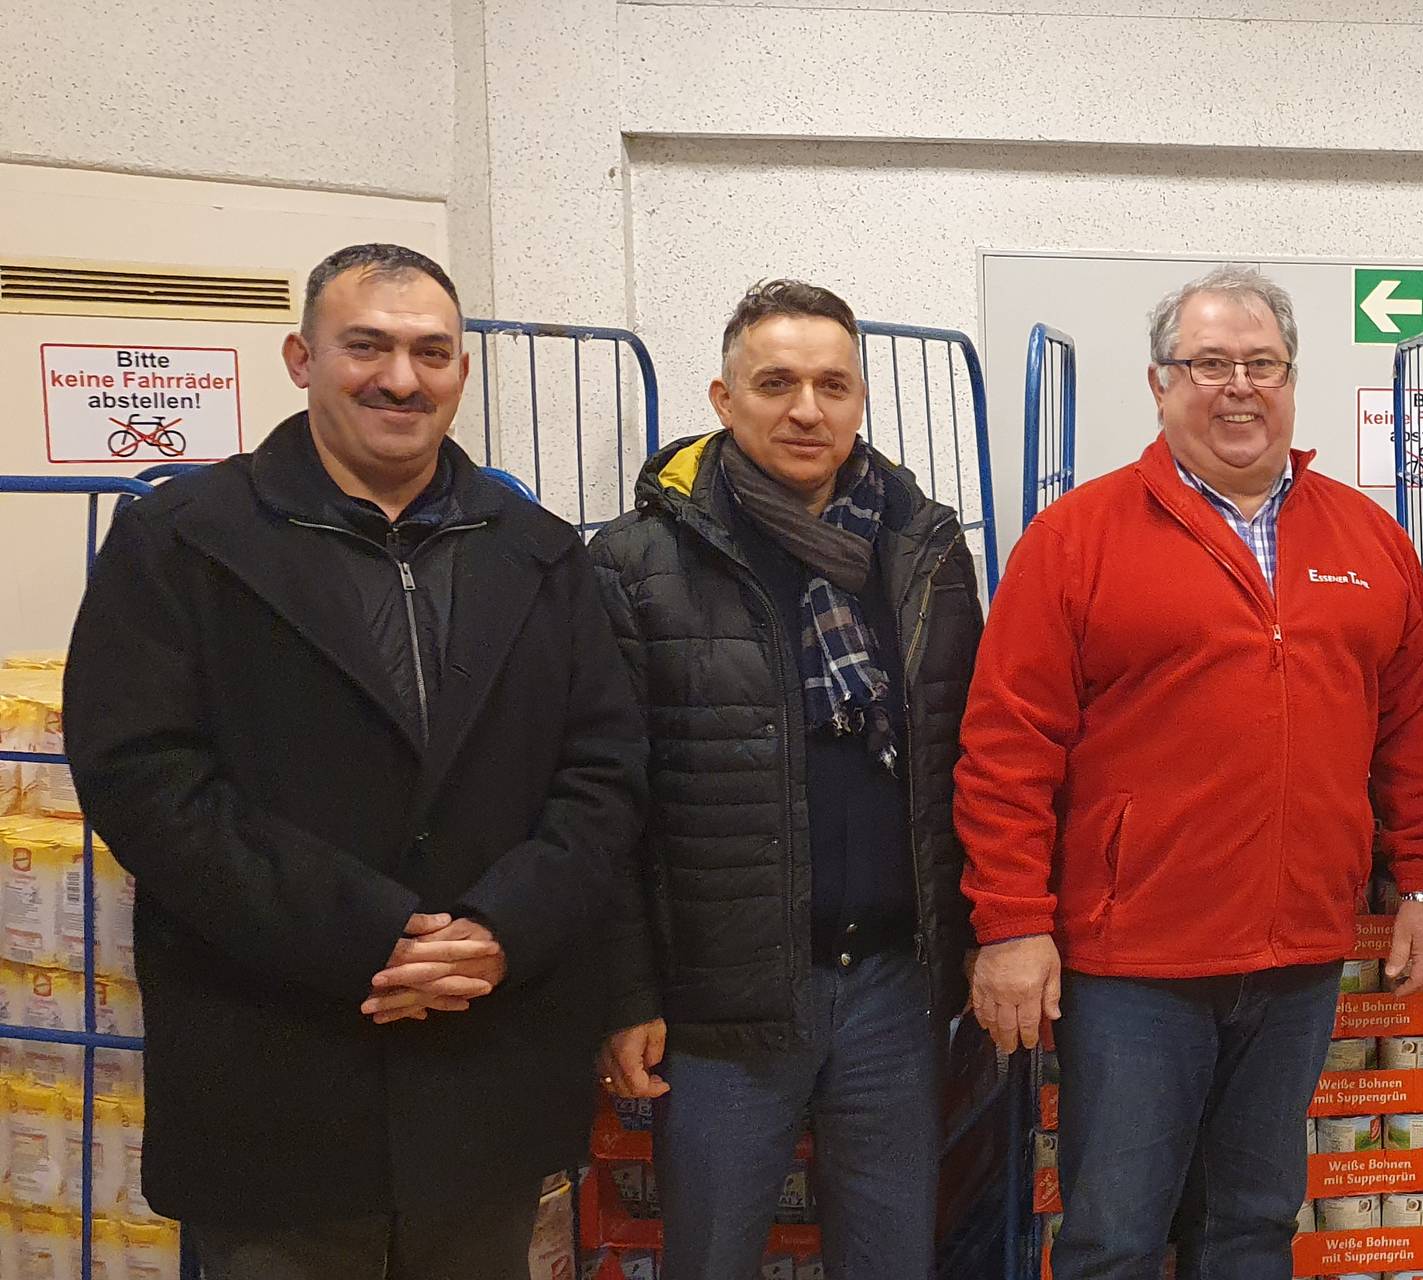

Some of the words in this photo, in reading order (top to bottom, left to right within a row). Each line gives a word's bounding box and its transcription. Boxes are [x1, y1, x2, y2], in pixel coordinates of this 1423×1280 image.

[117, 351, 170, 369] Bitte
[51, 370, 115, 388] keine
[123, 371, 234, 390] Fahrräder
[88, 392, 201, 409] abstellen!
[1356, 924, 1394, 935] Bohne
[1336, 1002, 1359, 1013] eiße
[1363, 1001, 1406, 1013] Bohnen
[1341, 1014, 1411, 1029] Suppengrün
[1319, 1080, 1355, 1091] Weiße
[1359, 1078, 1403, 1089] Bohnen
[1314, 1093, 1333, 1105] mit
[1337, 1092, 1407, 1105] Suppengrün
[1329, 1160, 1365, 1172] Weiße
[1369, 1158, 1412, 1170] Bohnen
[1324, 1175, 1343, 1186] mit
[1347, 1172, 1417, 1186] Suppengrün
[1326, 1238, 1363, 1250] Weiße
[1366, 1236, 1410, 1248] Bohnen
[1322, 1253, 1341, 1264] mit
[1345, 1250, 1415, 1265] Suppengrün
